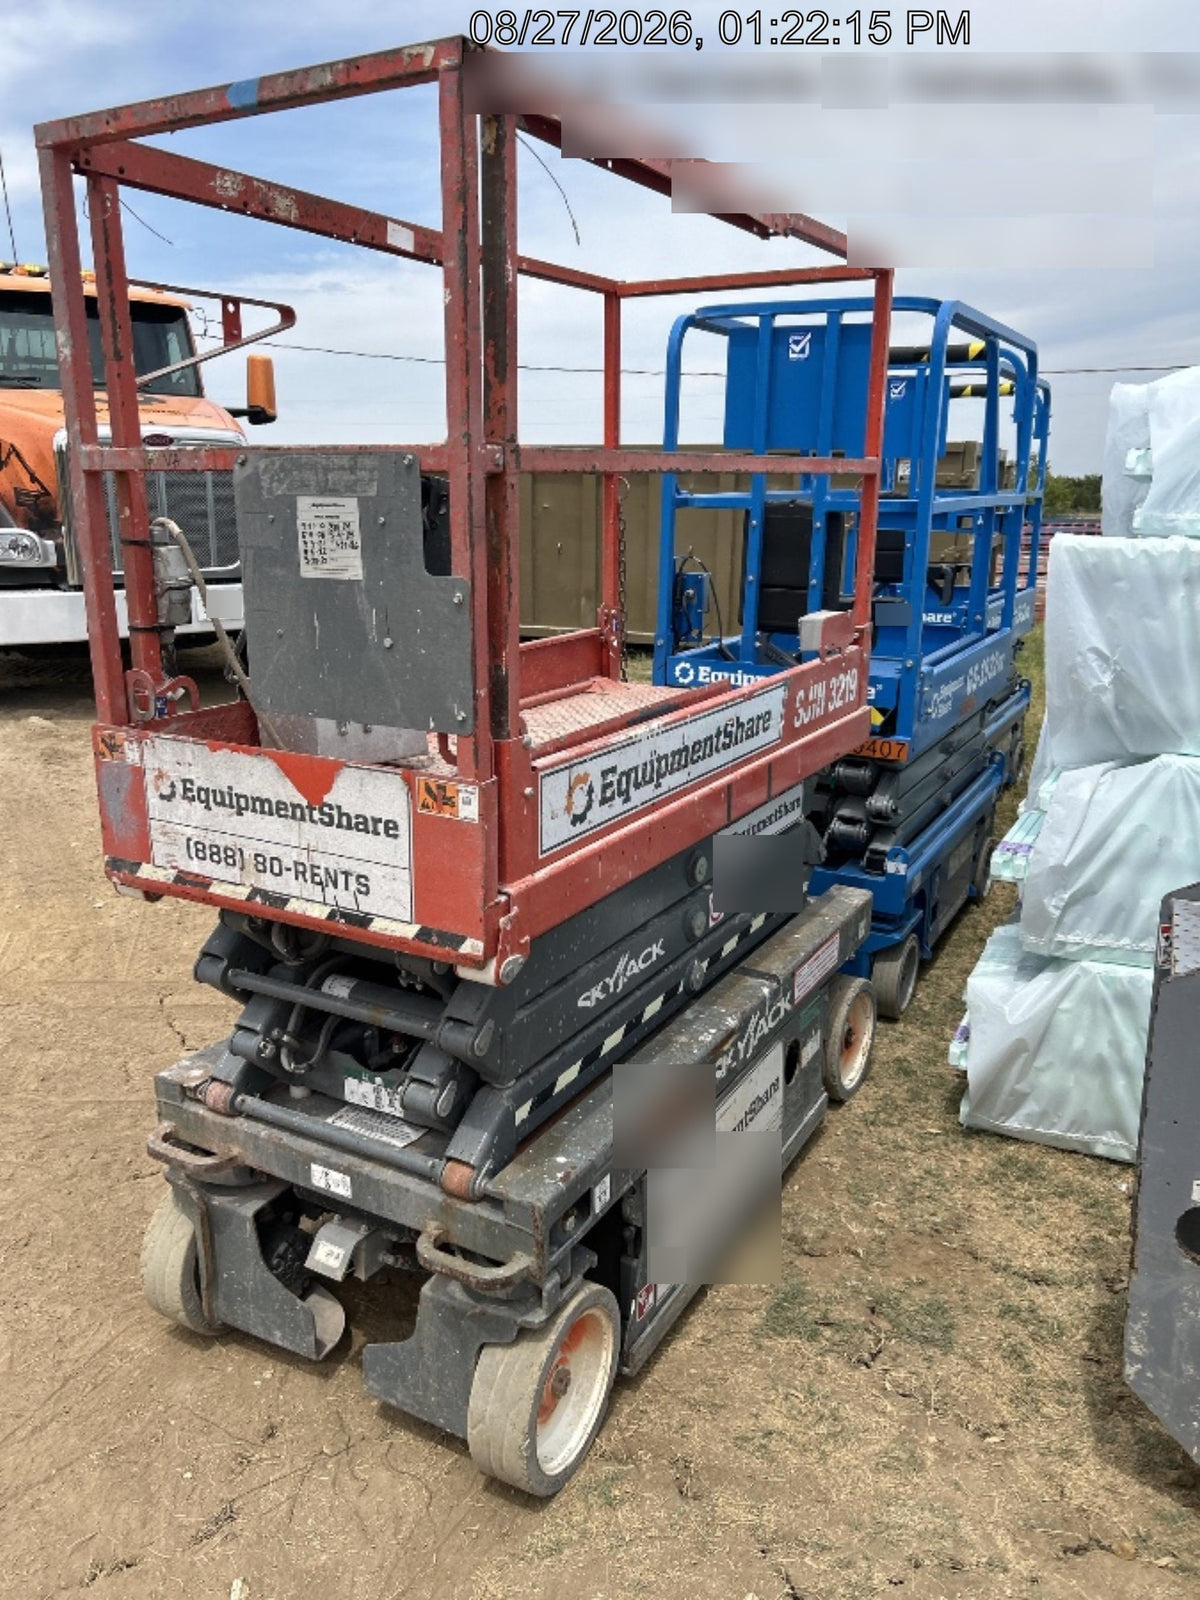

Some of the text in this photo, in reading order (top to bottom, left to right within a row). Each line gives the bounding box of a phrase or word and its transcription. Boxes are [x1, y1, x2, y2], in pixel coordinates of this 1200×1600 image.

[827, 668, 858, 713] 3219
[598, 710, 773, 807] EquipmentShare
[180, 777, 400, 840] EquipmentShare
[186, 836, 245, 871] (888)
